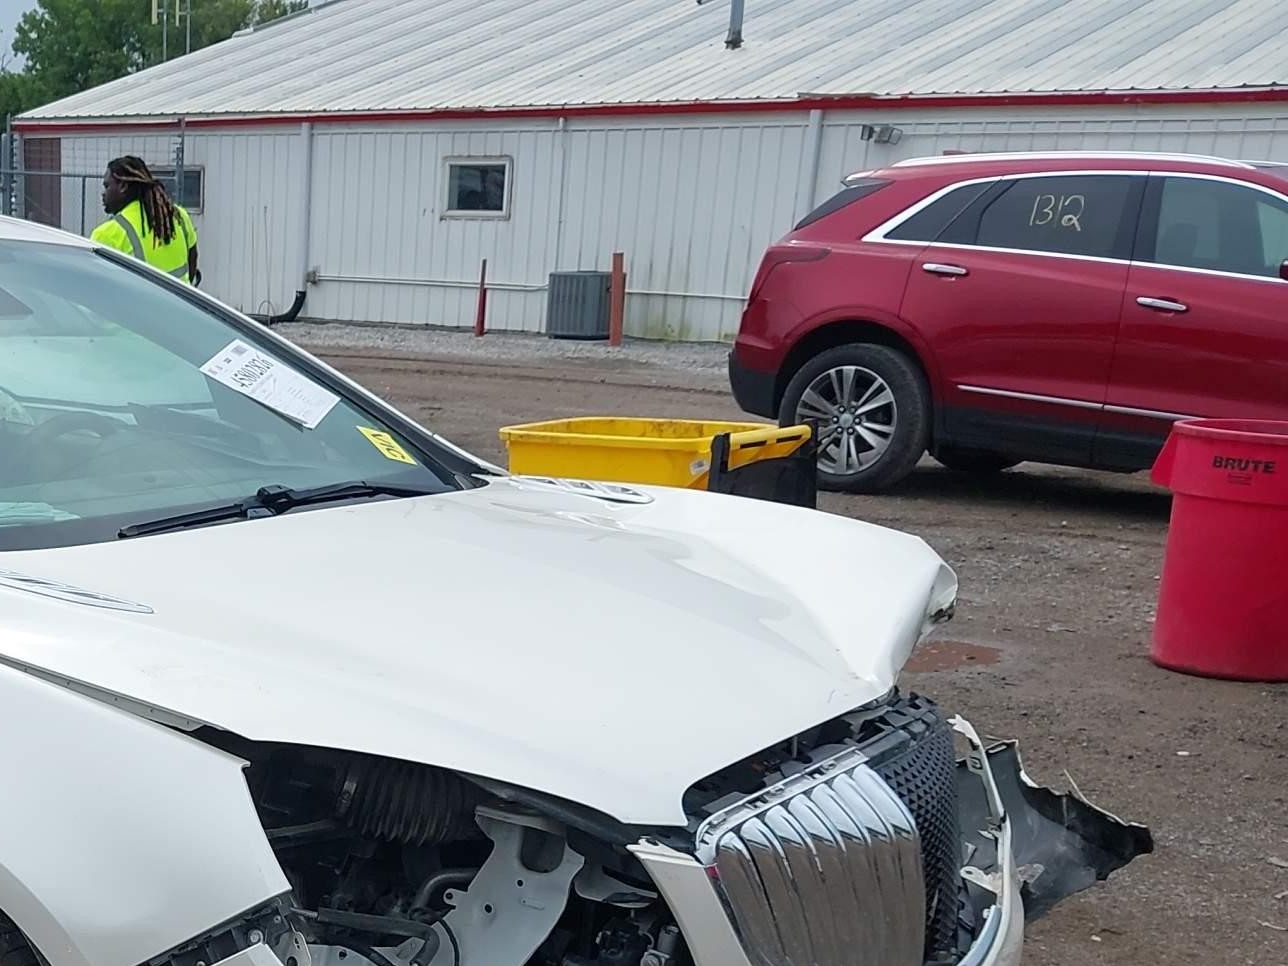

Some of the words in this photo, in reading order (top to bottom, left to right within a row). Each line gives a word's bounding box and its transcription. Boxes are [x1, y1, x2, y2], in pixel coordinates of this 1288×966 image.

[1029, 194, 1085, 232] 1312
[231, 352, 274, 389] 45802826
[1212, 455, 1277, 474] BRUTE
